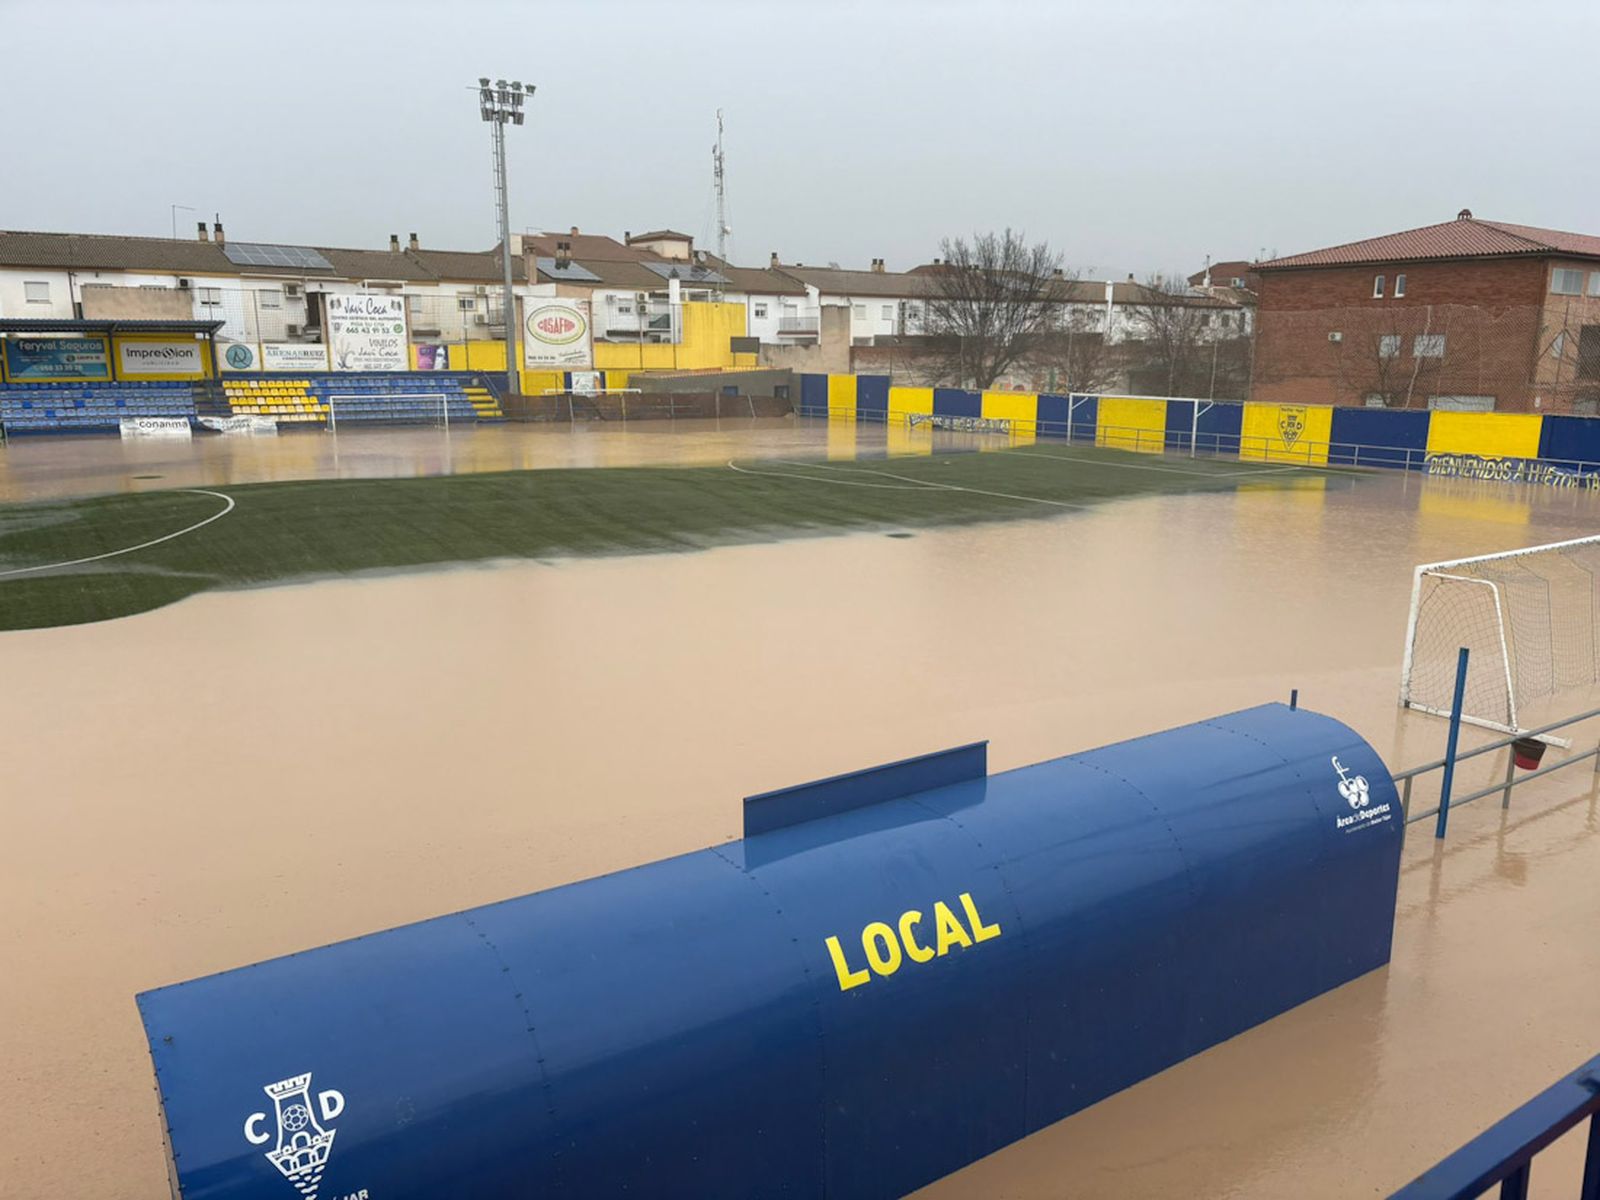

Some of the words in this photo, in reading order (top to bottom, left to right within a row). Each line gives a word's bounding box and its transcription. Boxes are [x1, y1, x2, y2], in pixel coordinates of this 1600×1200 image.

[1428, 456, 1512, 481] BIENVENIDOS
[1514, 462, 1525, 480] A
[825, 893, 1001, 991] LOCAL
[244, 1112, 270, 1144] C
[318, 1089, 345, 1120] D
